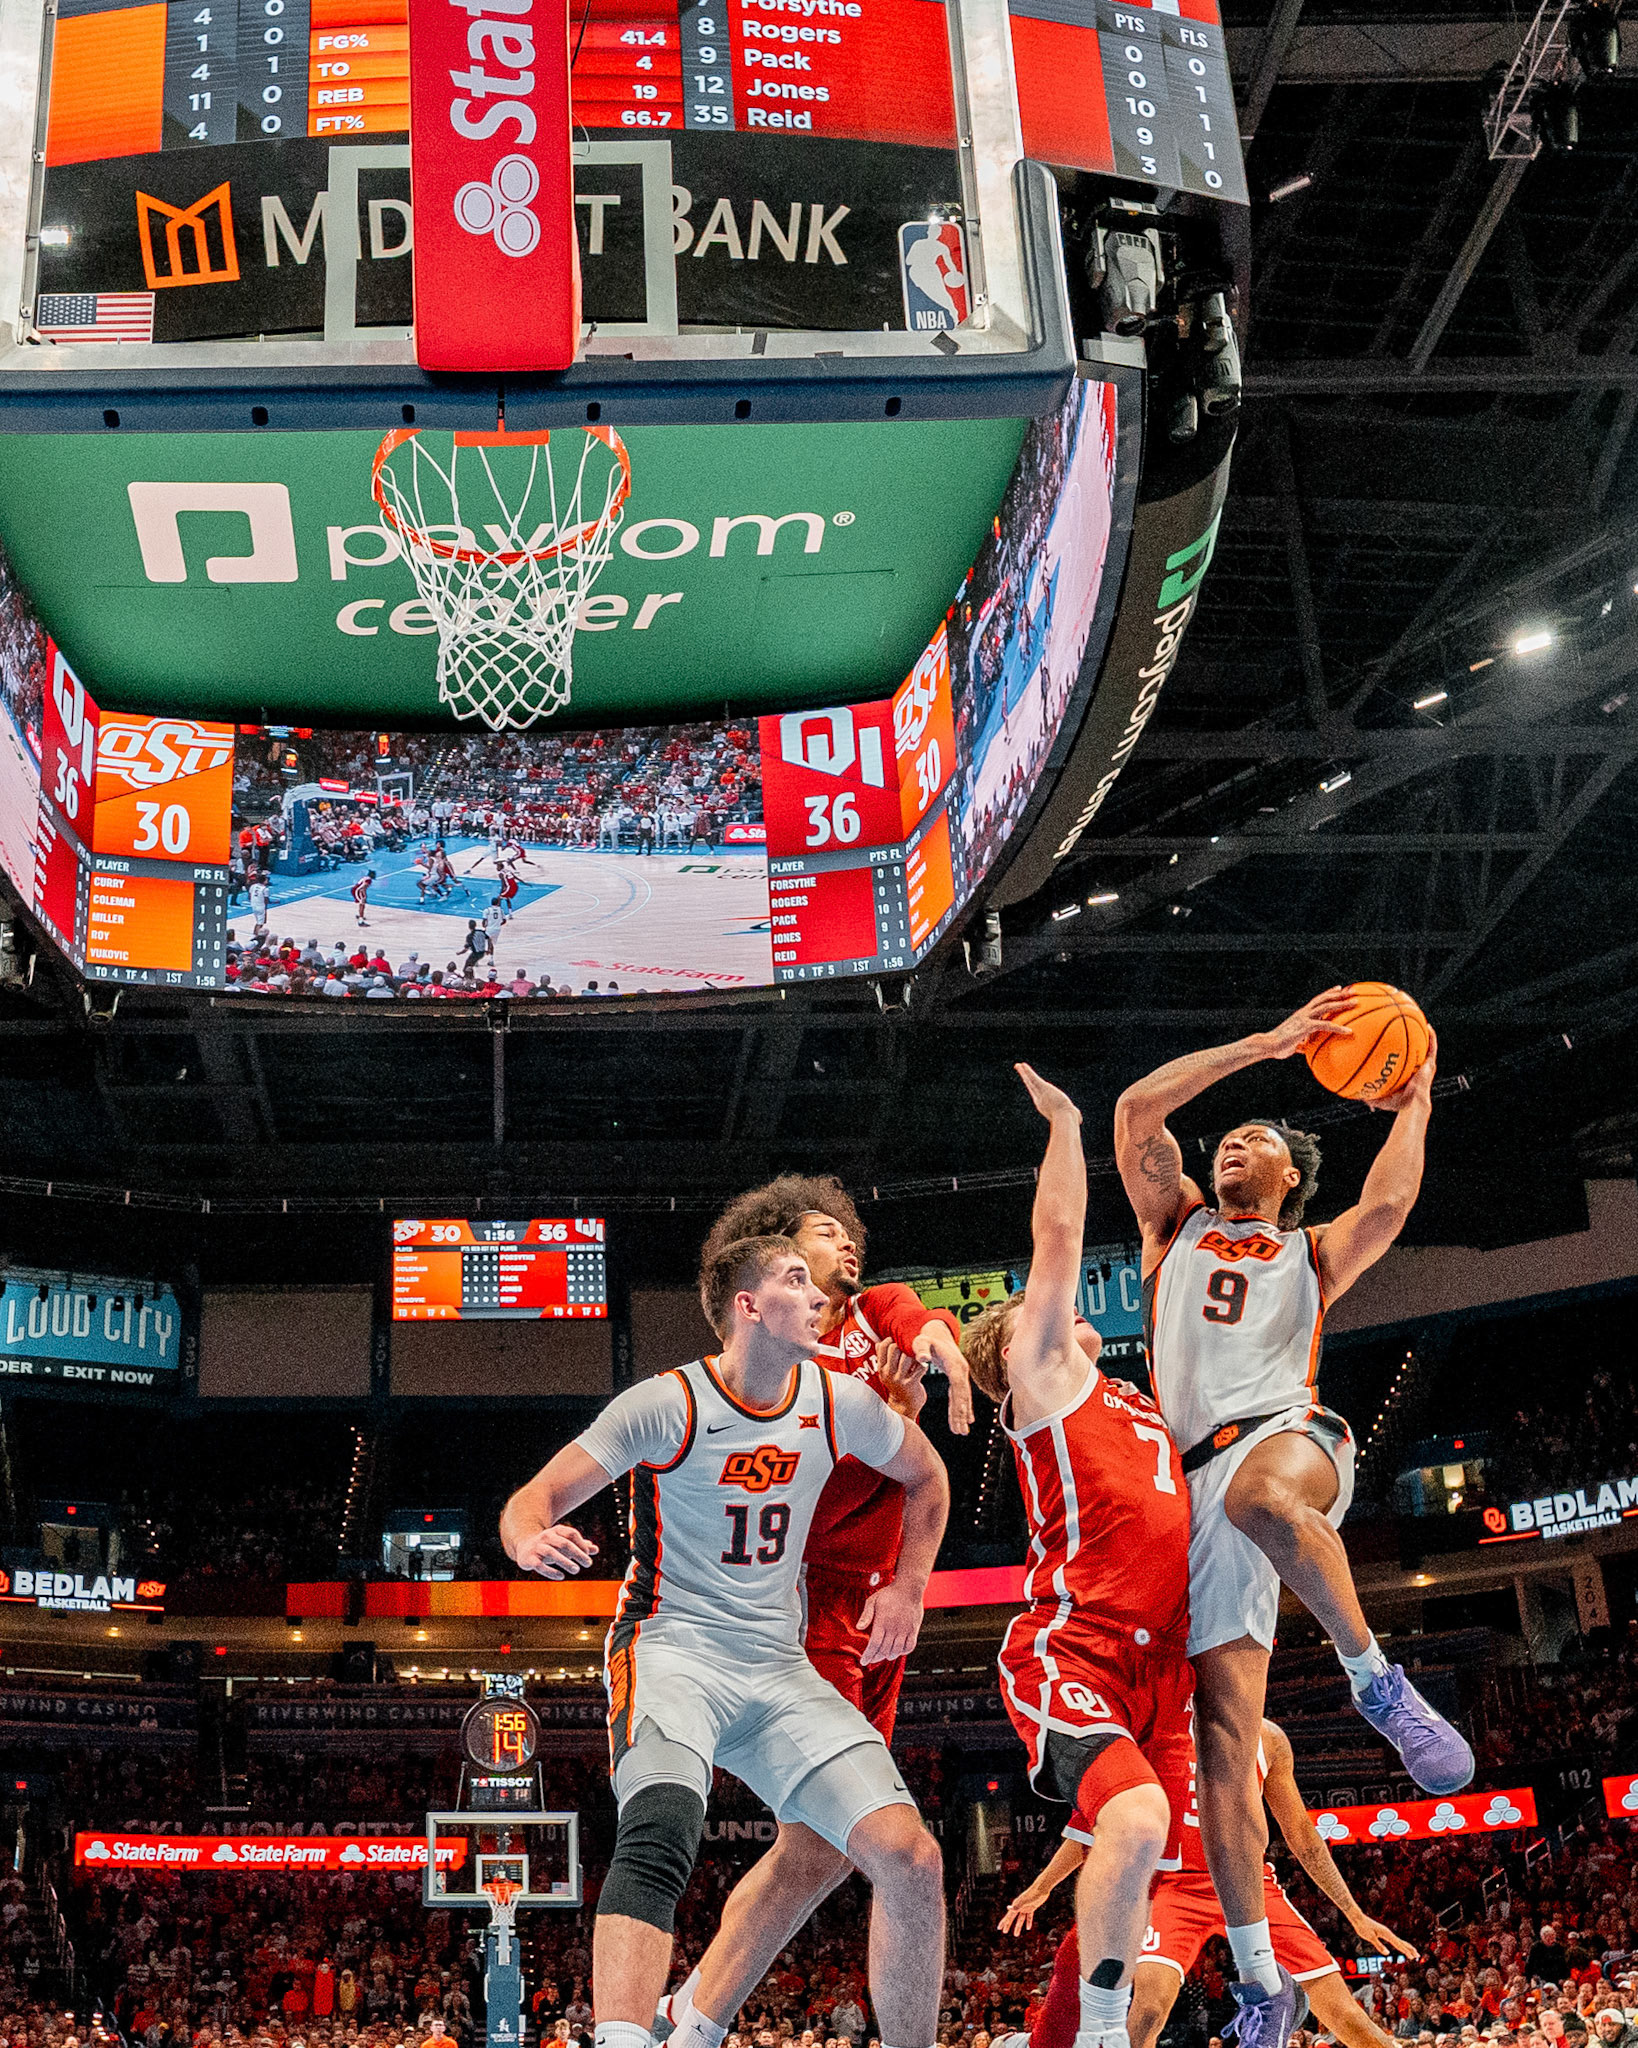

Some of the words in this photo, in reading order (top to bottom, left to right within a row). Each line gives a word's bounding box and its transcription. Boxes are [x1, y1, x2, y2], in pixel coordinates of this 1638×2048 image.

[193, 8, 212, 25] 4
[263, 27, 284, 45] 0
[619, 30, 667, 46] 41.4
[697, 17, 716, 36] 8
[742, 19, 842, 44] Rogers
[1114, 13, 1146, 33] PTS
[1179, 27, 1208, 48] FLS
[196, 34, 209, 52] 1
[267, 56, 279, 74] 1
[318, 34, 369, 51] FG%
[317, 62, 350, 77] TO
[635, 56, 653, 70] 4
[698, 46, 717, 64] 9
[744, 48, 812, 71] Pack
[1124, 45, 1144, 63] 0
[1188, 58, 1207, 76] 0
[190, 63, 211, 81] 4
[261, 85, 283, 104] 0
[317, 87, 364, 105] REB
[632, 85, 658, 100] 19
[694, 75, 725, 94] 12
[746, 78, 830, 102] Jones
[1128, 70, 1147, 89] 0
[1195, 86, 1207, 103] 1
[188, 92, 212, 111] 11
[260, 115, 282, 134] 0
[316, 115, 365, 132] FT%
[620, 110, 672, 127] 66.7
[694, 105, 729, 124] 35
[747, 107, 813, 129] Reid
[1125, 97, 1156, 118] 10
[1199, 114, 1211, 131] 1
[188, 122, 208, 141] 4
[1136, 127, 1153, 146] 9
[1203, 142, 1215, 160] 1
[1140, 155, 1157, 175] 3
[1204, 170, 1223, 189] 0
[915, 310, 948, 330] NBA
[1111, 595, 1193, 761] paycom
[54, 747, 79, 820] 36
[915, 737, 941, 811] 30
[133, 801, 190, 854] 30
[804, 791, 862, 847] 36
[96, 859, 130, 872] PLAYER
[194, 869, 211, 880] PTS
[214, 870, 226, 881] FL
[770, 861, 805, 873] PLAYER
[869, 850, 888, 862] PTS
[889, 848, 902, 859] FL
[93, 876, 125, 889] CURRY
[200, 887, 207, 896] 4
[215, 888, 222, 897] 0
[770, 877, 817, 891] FORSYTHE
[877, 868, 885, 879] 0
[893, 866, 901, 877] 0
[92, 894, 136, 908] COLEMAN
[200, 904, 206, 914] 1
[215, 905, 222, 915] 0
[771, 895, 809, 909] ROGERS
[878, 886, 886, 897] 0
[896, 884, 902, 894] 1
[91, 912, 125, 925] MILLER
[198, 922, 205, 932] 4
[216, 923, 221, 933] 1
[772, 914, 797, 927] PACK
[878, 903, 890, 915] 10
[897, 901, 903, 912] 1
[90, 930, 111, 941] ROY
[196, 940, 207, 949] 11
[213, 940, 221, 951] 0
[773, 932, 801, 944] JONES
[881, 921, 889, 932] 9
[899, 919, 905, 930] 1
[89, 948, 129, 961] VUKOVIC
[196, 958, 204, 967] 4
[213, 958, 220, 968] 0
[774, 950, 797, 962] REID
[882, 940, 890, 951] 3
[898, 938, 906, 948] 0
[95, 966, 108, 977] TO
[112, 968, 119, 978] 4
[126, 969, 138, 980] TF
[140, 971, 148, 980] 4
[165, 973, 183, 983] 1ST
[195, 976, 216, 986] 1:56
[782, 969, 795, 980] TO
[798, 967, 806, 978] 4
[812, 966, 824, 977] TF
[827, 964, 835, 975] 5
[852, 960, 870, 972] 1ST
[883, 956, 904, 968] 1:56
[430, 1224, 461, 1242] 30
[484, 1229, 516, 1241] 1:56
[538, 1223, 568, 1242] 36
[1196, 1230, 1284, 1262] OSU
[1202, 1268, 1249, 1325] 9
[6, 1294, 91, 1344] LOUD
[846, 1331, 870, 1354] SEC
[63, 1365, 106, 1380] EXIT
[110, 1368, 154, 1385] NOW
[718, 1444, 801, 1493] OSU
[1132, 1421, 1177, 1495] 7
[1510, 1477, 1638, 1531] BEDLAM
[720, 1503, 792, 1566] 19
[1542, 1510, 1622, 1539] BASKETBALL
[14, 1570, 136, 1601] BEDLAM
[38, 1597, 111, 1611] BASKETBALL
[1058, 1682, 1113, 1719] OU
[494, 1712, 527, 1731] 1:56
[493, 1731, 524, 1765] 14
[488, 1778, 533, 1787] TISSOT
[1559, 1768, 1592, 1790] 102
[1015, 1814, 1047, 1833] 102
[111, 1841, 199, 1862] StateFarm
[238, 1844, 326, 1863] StateFarm
